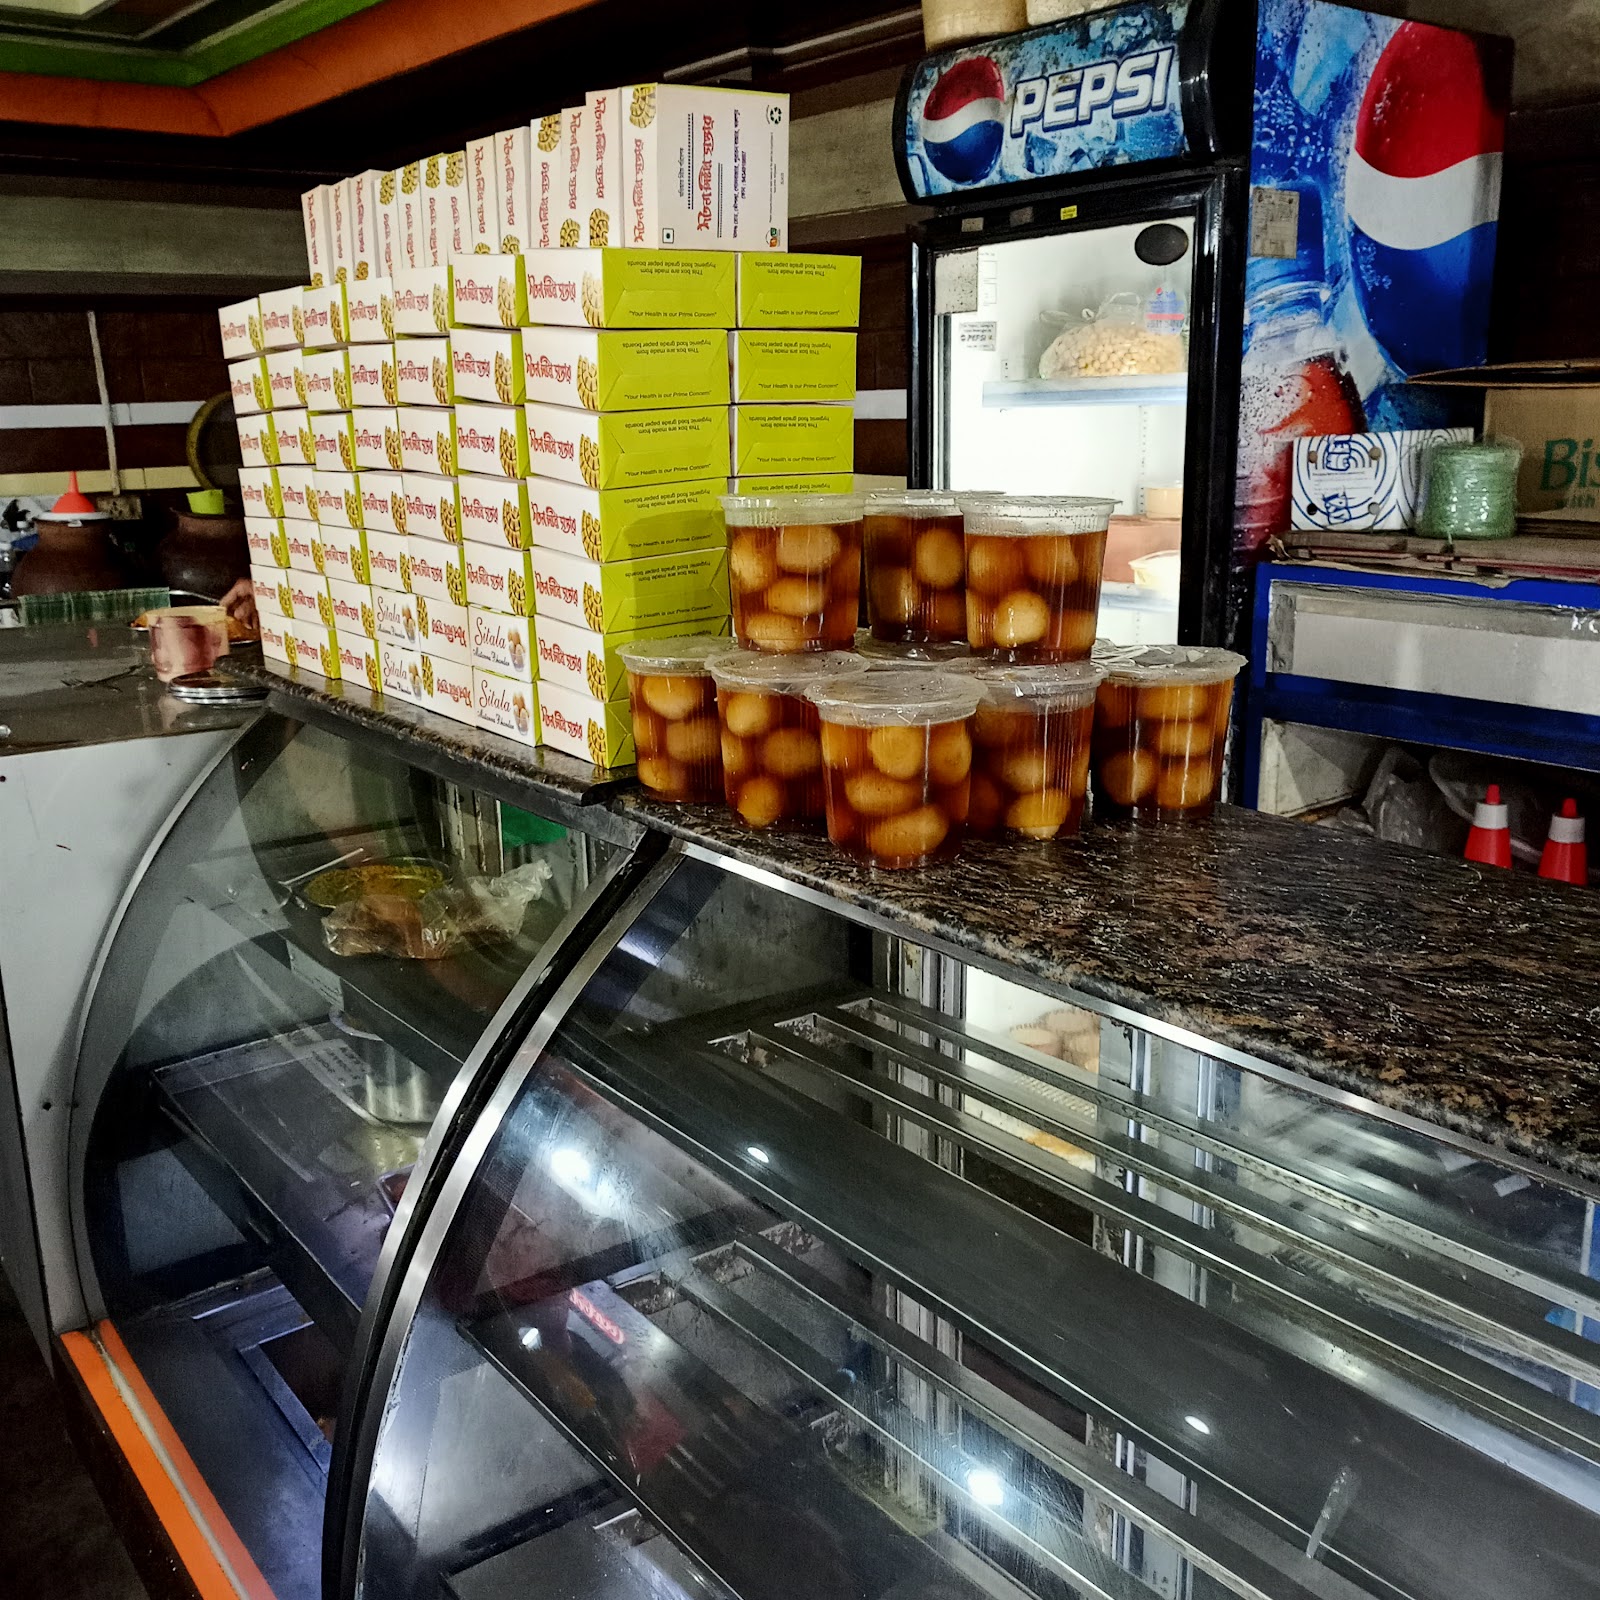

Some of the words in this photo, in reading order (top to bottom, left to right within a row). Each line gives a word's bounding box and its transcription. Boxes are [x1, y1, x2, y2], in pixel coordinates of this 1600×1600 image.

[1010, 46, 1175, 138] PEPSI
[377, 596, 400, 623] Sitala
[475, 617, 506, 649] Sitala
[384, 652, 407, 679] Sitala
[479, 680, 511, 712] Sitala
